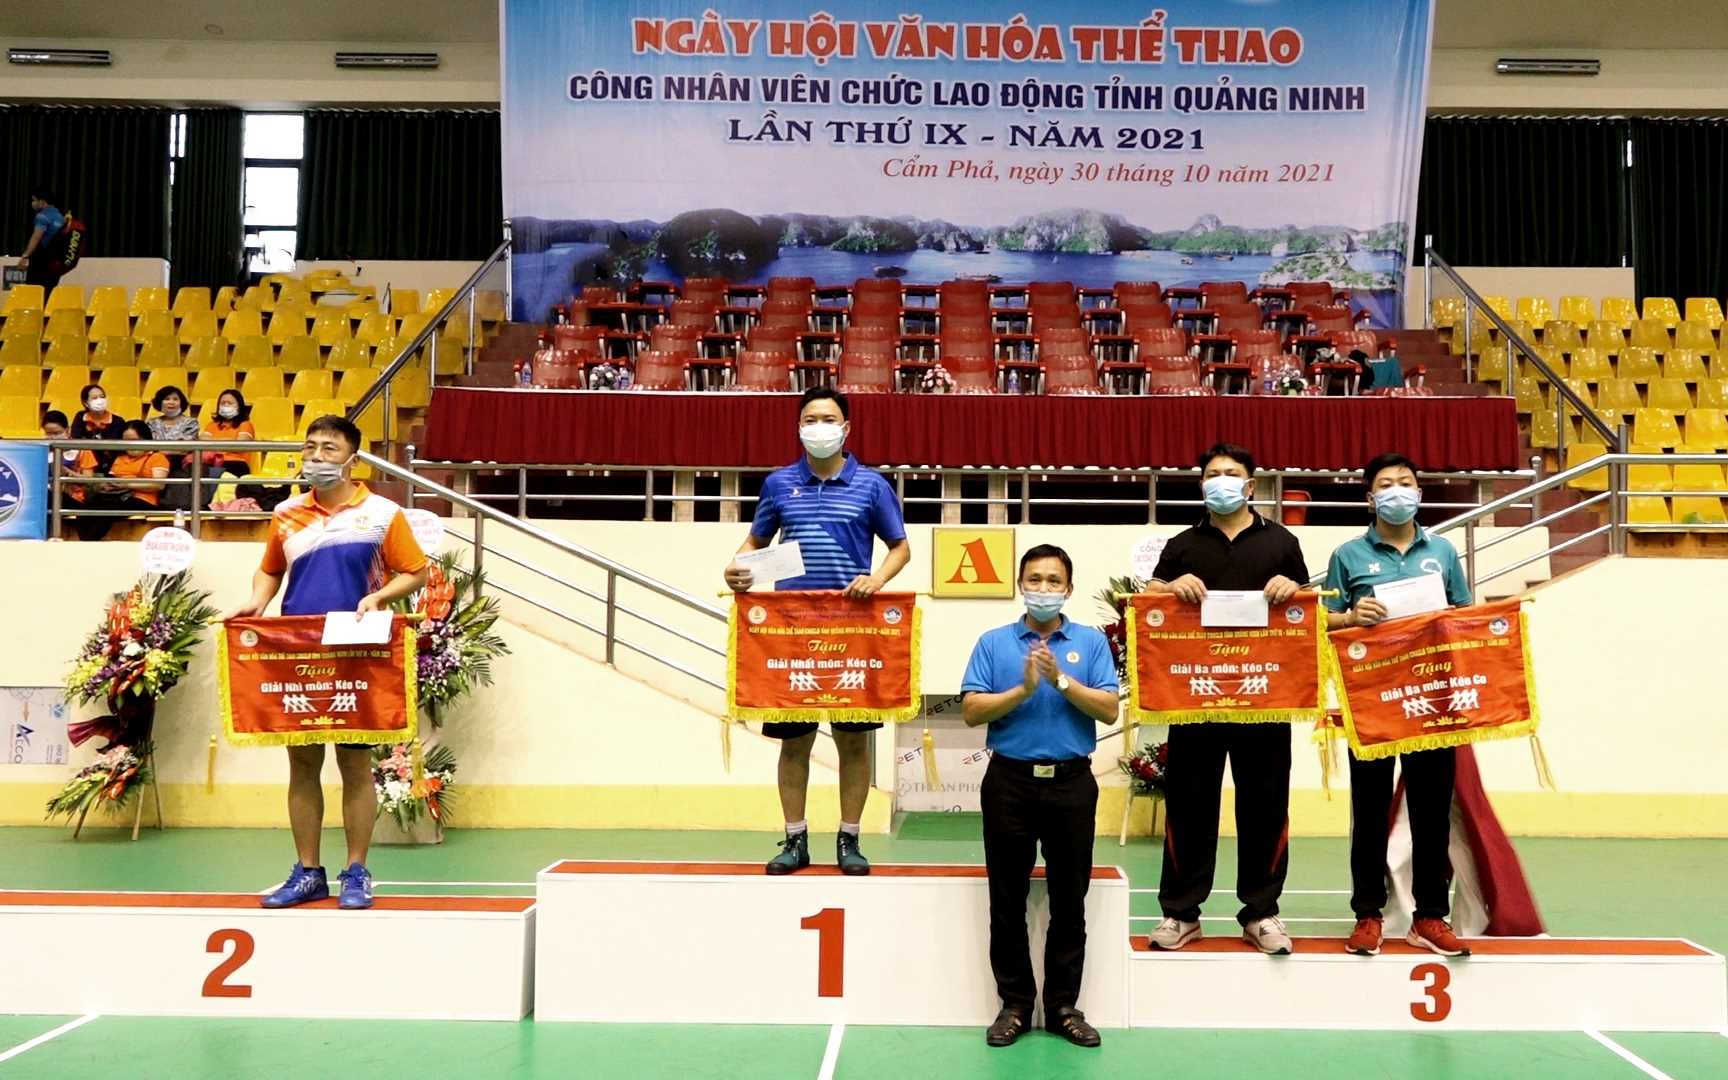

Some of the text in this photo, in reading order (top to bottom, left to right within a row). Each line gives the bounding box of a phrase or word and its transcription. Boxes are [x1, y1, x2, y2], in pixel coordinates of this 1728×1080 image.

[634, 11, 1302, 64] NGÀY HỘI VĂN HÓA THỂ THAO
[570, 71, 1365, 113] CÔNG NHÂN VIÊN CHỨC LAO ĐỘNG TỈNH QUẢNG NINH
[729, 110, 813, 142] LẦN
[826, 117, 913, 145] THỨ
[925, 123, 968, 146] IX
[1009, 121, 1105, 149] NĂM
[1117, 128, 1205, 150] 2021
[882, 154, 1335, 187] Cẩm Phả, ngày 30 tháng 10 năm 2021
[945, 538, 1004, 584] A
[767, 657, 883, 669] Giải Nhất môn: Kéo Co
[1170, 662, 1280, 675] Giải Ba môn: Kéo Co
[260, 681, 283, 693] Giải
[306, 680, 334, 691] môn:
[335, 680, 353, 690] Kéo
[355, 679, 368, 690] Co
[1380, 674, 1488, 702] Giải Ba môn: Kéo Co
[203, 929, 254, 998] 2
[801, 908, 845, 998] 1
[1410, 963, 1452, 1023] 3
